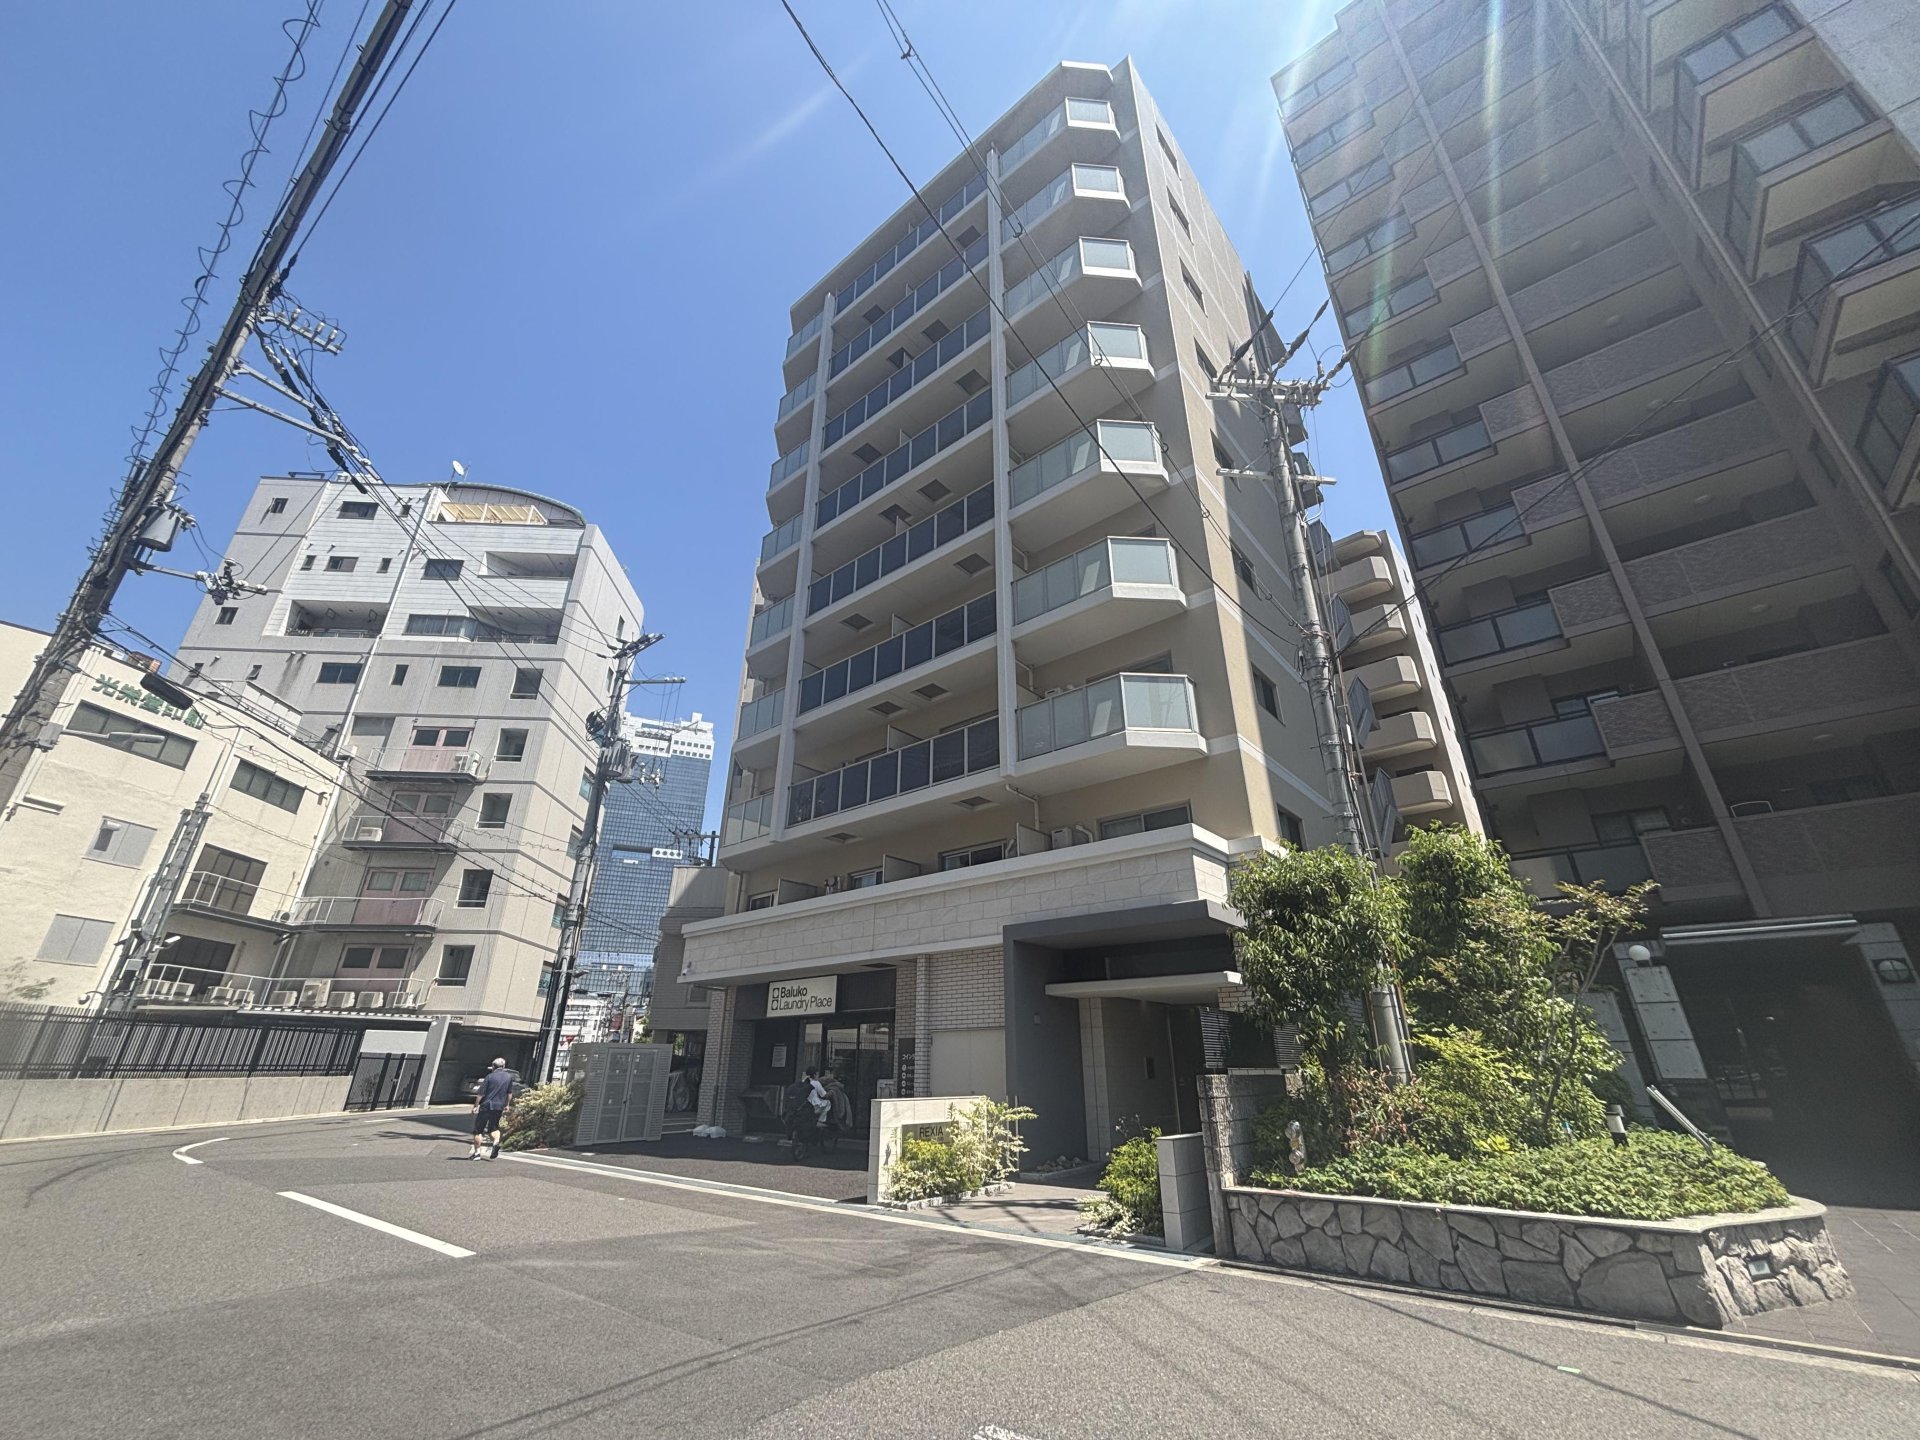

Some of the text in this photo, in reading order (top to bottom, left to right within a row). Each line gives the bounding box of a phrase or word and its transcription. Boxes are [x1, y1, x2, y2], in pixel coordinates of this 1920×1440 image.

[780, 986, 808, 998] Baluko
[779, 995, 833, 1012] Laundry Place
[919, 1126, 944, 1138] REXIA
